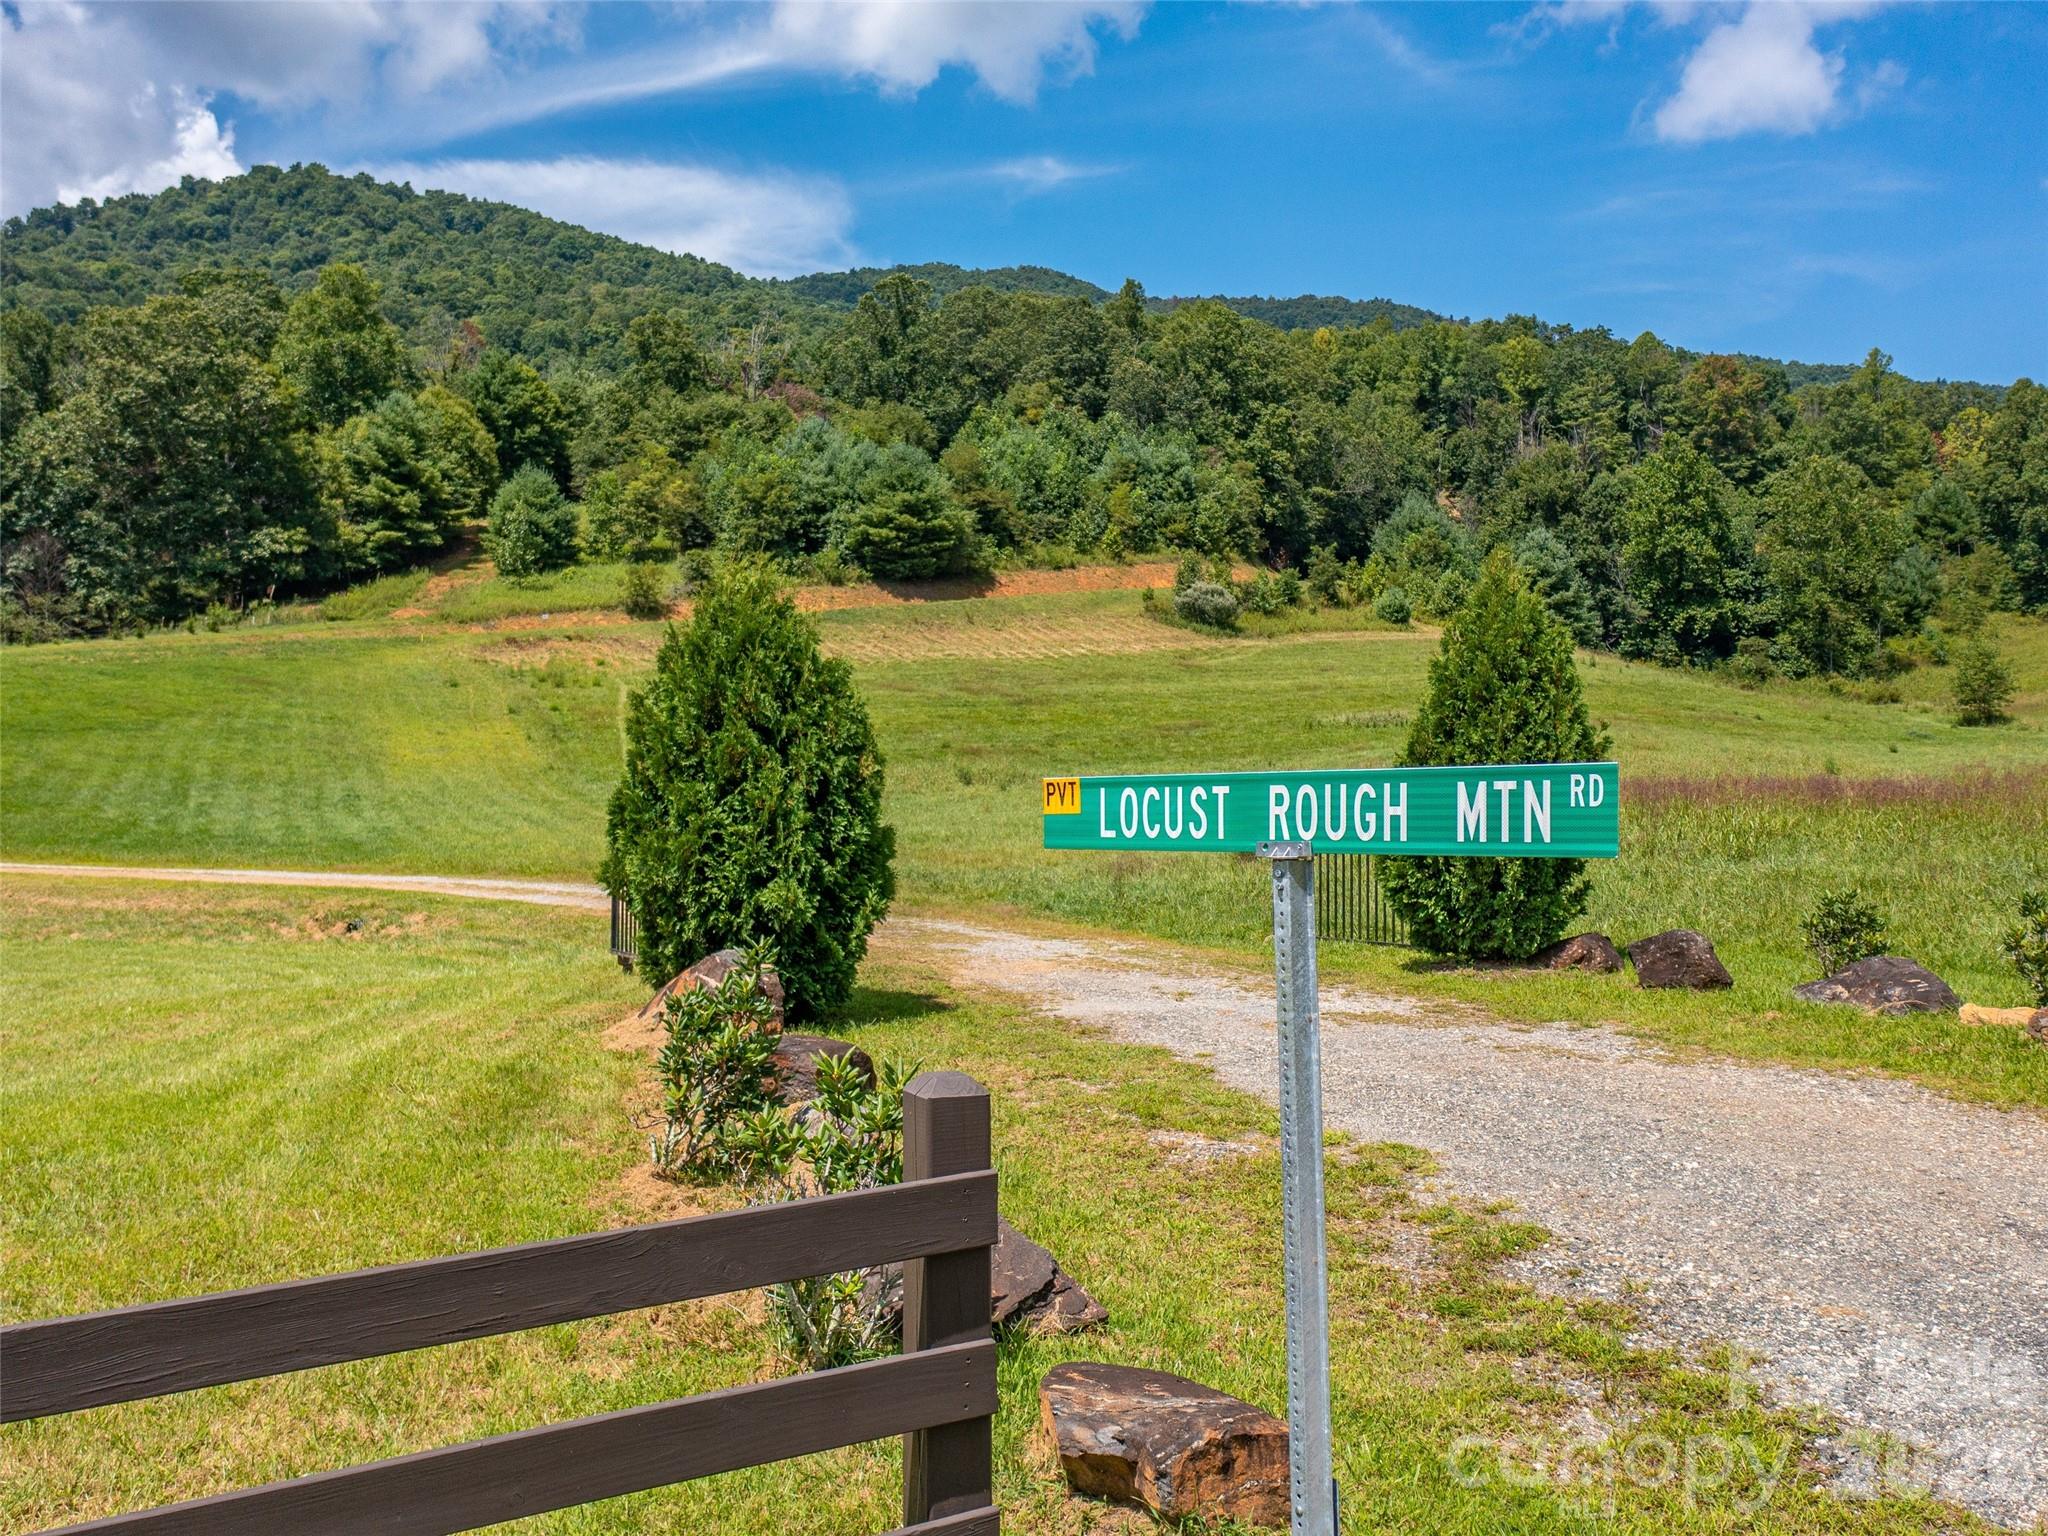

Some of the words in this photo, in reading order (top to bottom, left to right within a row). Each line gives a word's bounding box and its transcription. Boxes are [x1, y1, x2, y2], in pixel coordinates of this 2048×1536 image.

[1046, 781, 1077, 807] PVT
[1570, 773, 1605, 808] RD
[1099, 785, 1230, 840] LOCUST
[1268, 782, 1408, 842] ROUGH
[1457, 779, 1552, 844] MTN
